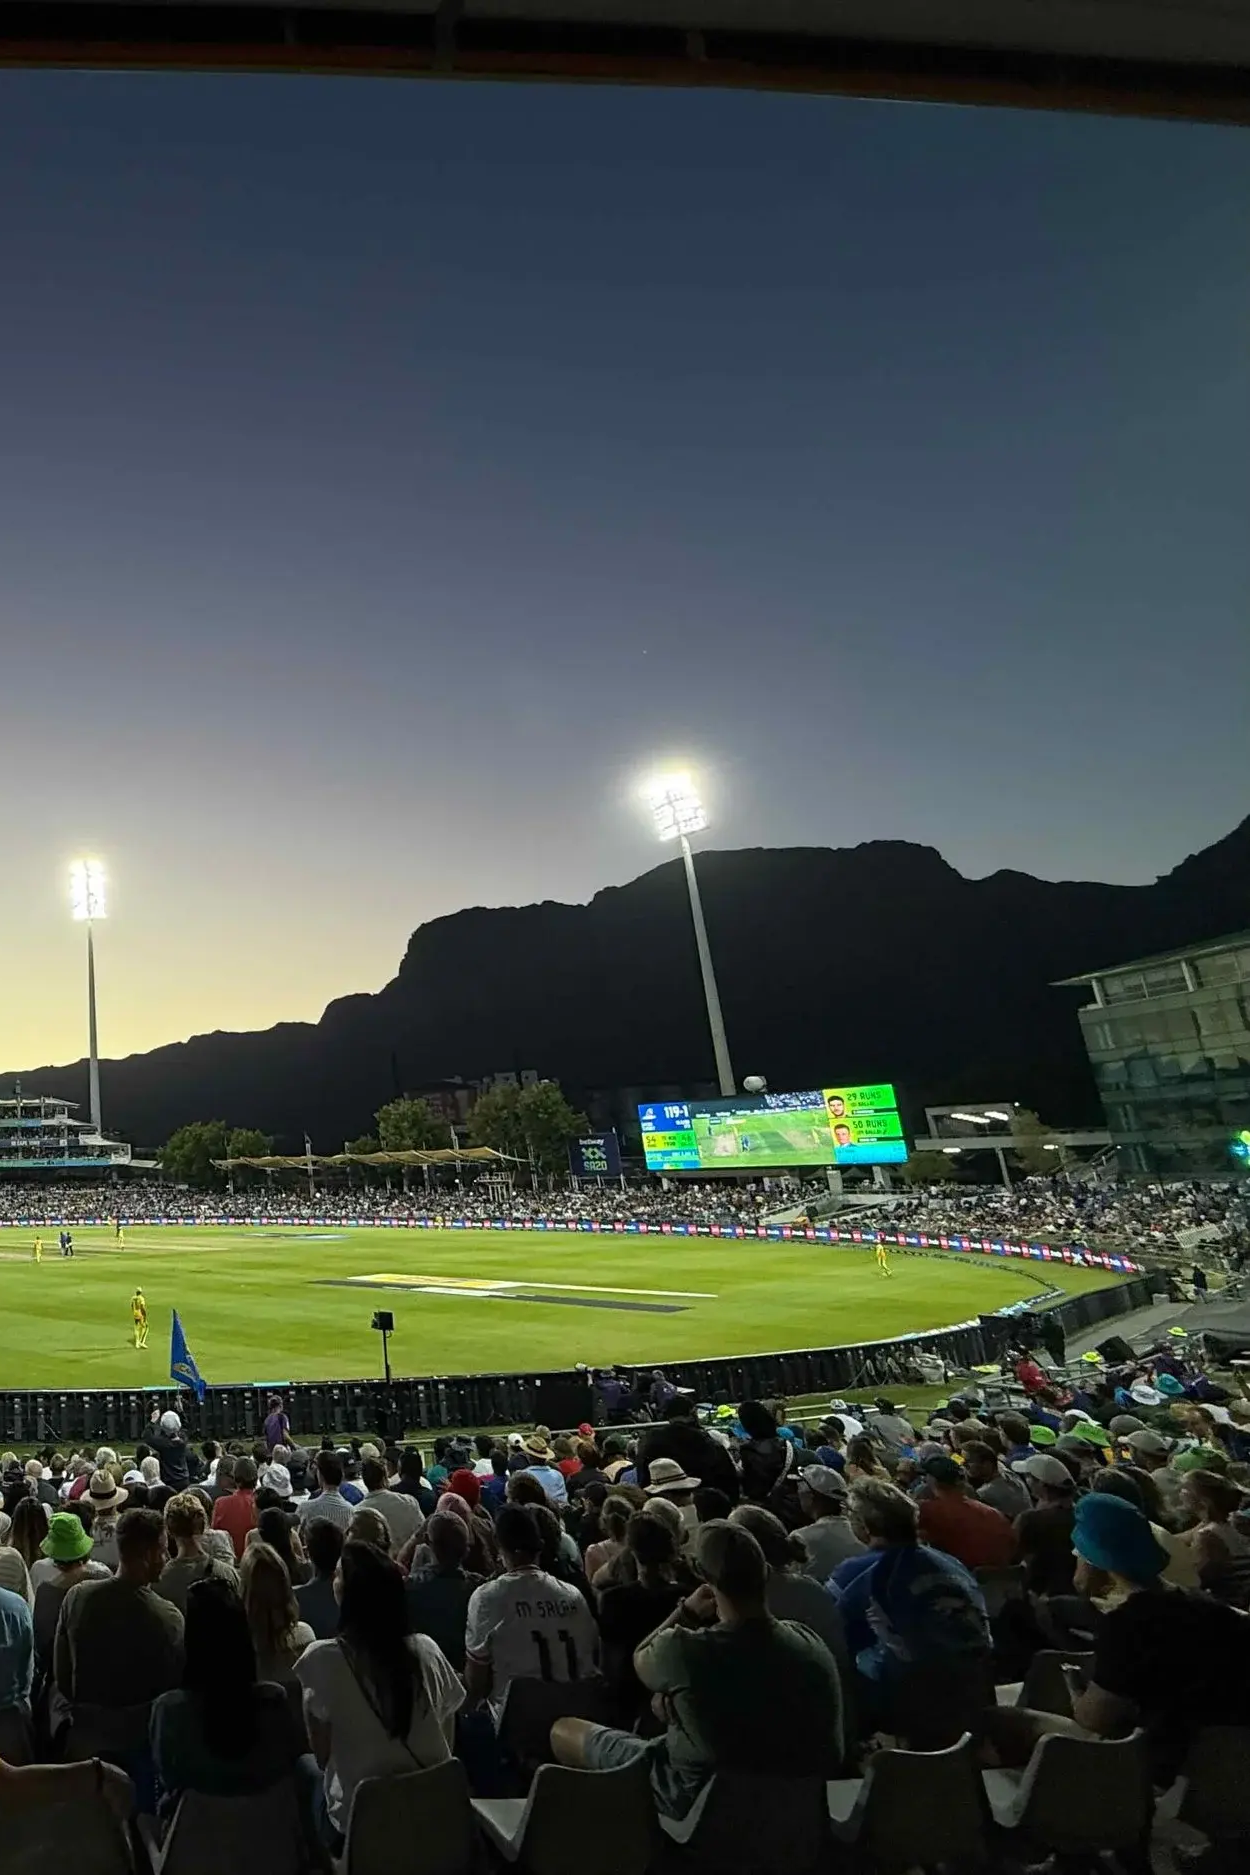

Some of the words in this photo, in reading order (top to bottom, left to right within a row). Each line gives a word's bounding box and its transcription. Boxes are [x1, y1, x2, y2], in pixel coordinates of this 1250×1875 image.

[859, 1091, 882, 1100] RUNS
[663, 1105, 689, 1118] 119-1
[866, 1120, 888, 1128] RUNS
[584, 1160, 607, 1170] SA20
[516, 1601, 532, 1618] M
[536, 1599, 578, 1618] SALAH
[531, 1630, 579, 1682] 11
